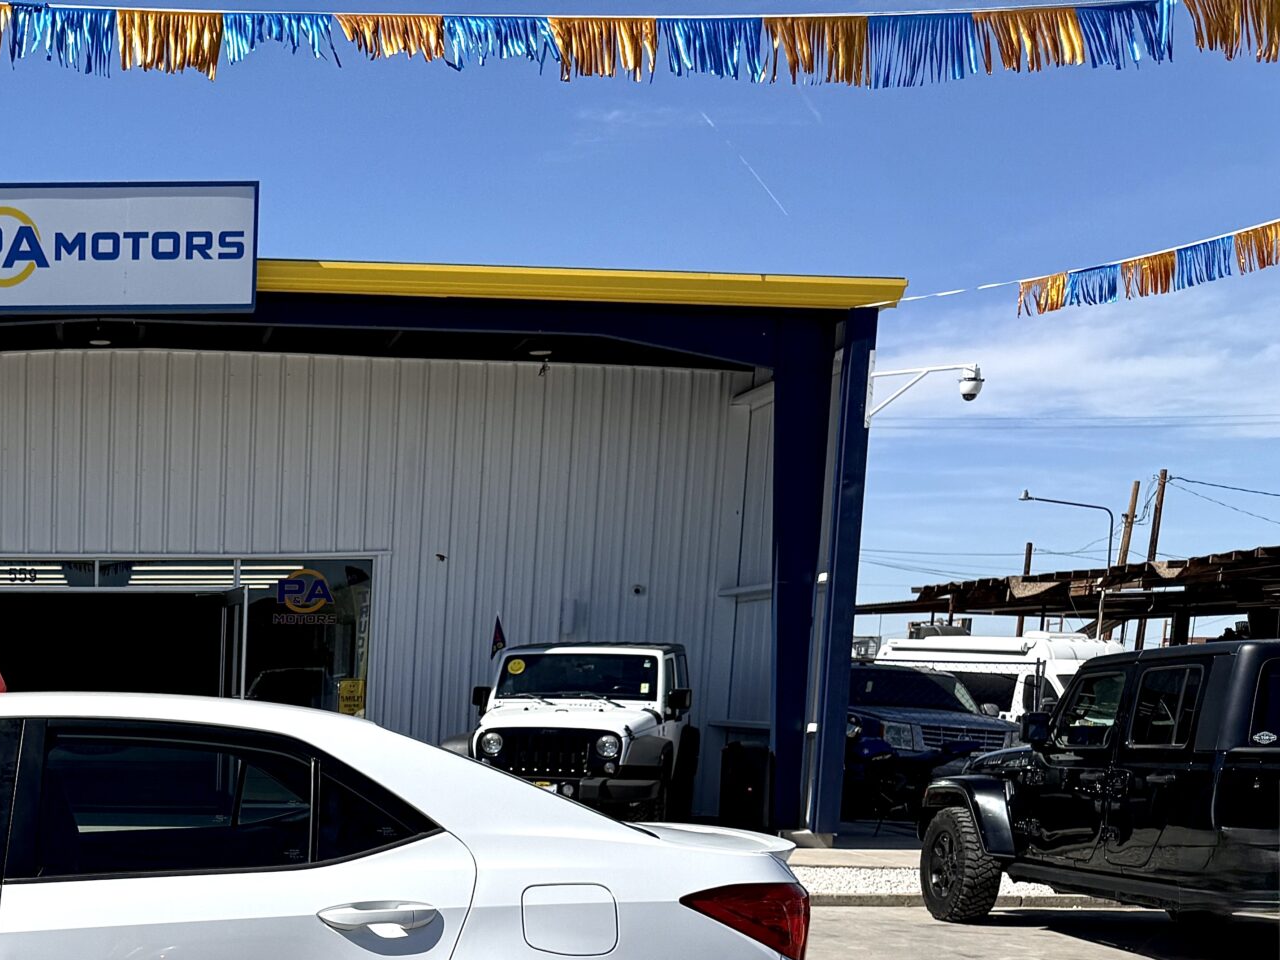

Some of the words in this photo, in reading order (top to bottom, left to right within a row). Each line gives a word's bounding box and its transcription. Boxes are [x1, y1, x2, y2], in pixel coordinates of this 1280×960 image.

[54, 231, 245, 261] MOTORS
[9, 568, 37, 582] 559
[272, 613, 337, 625] MOTORS
